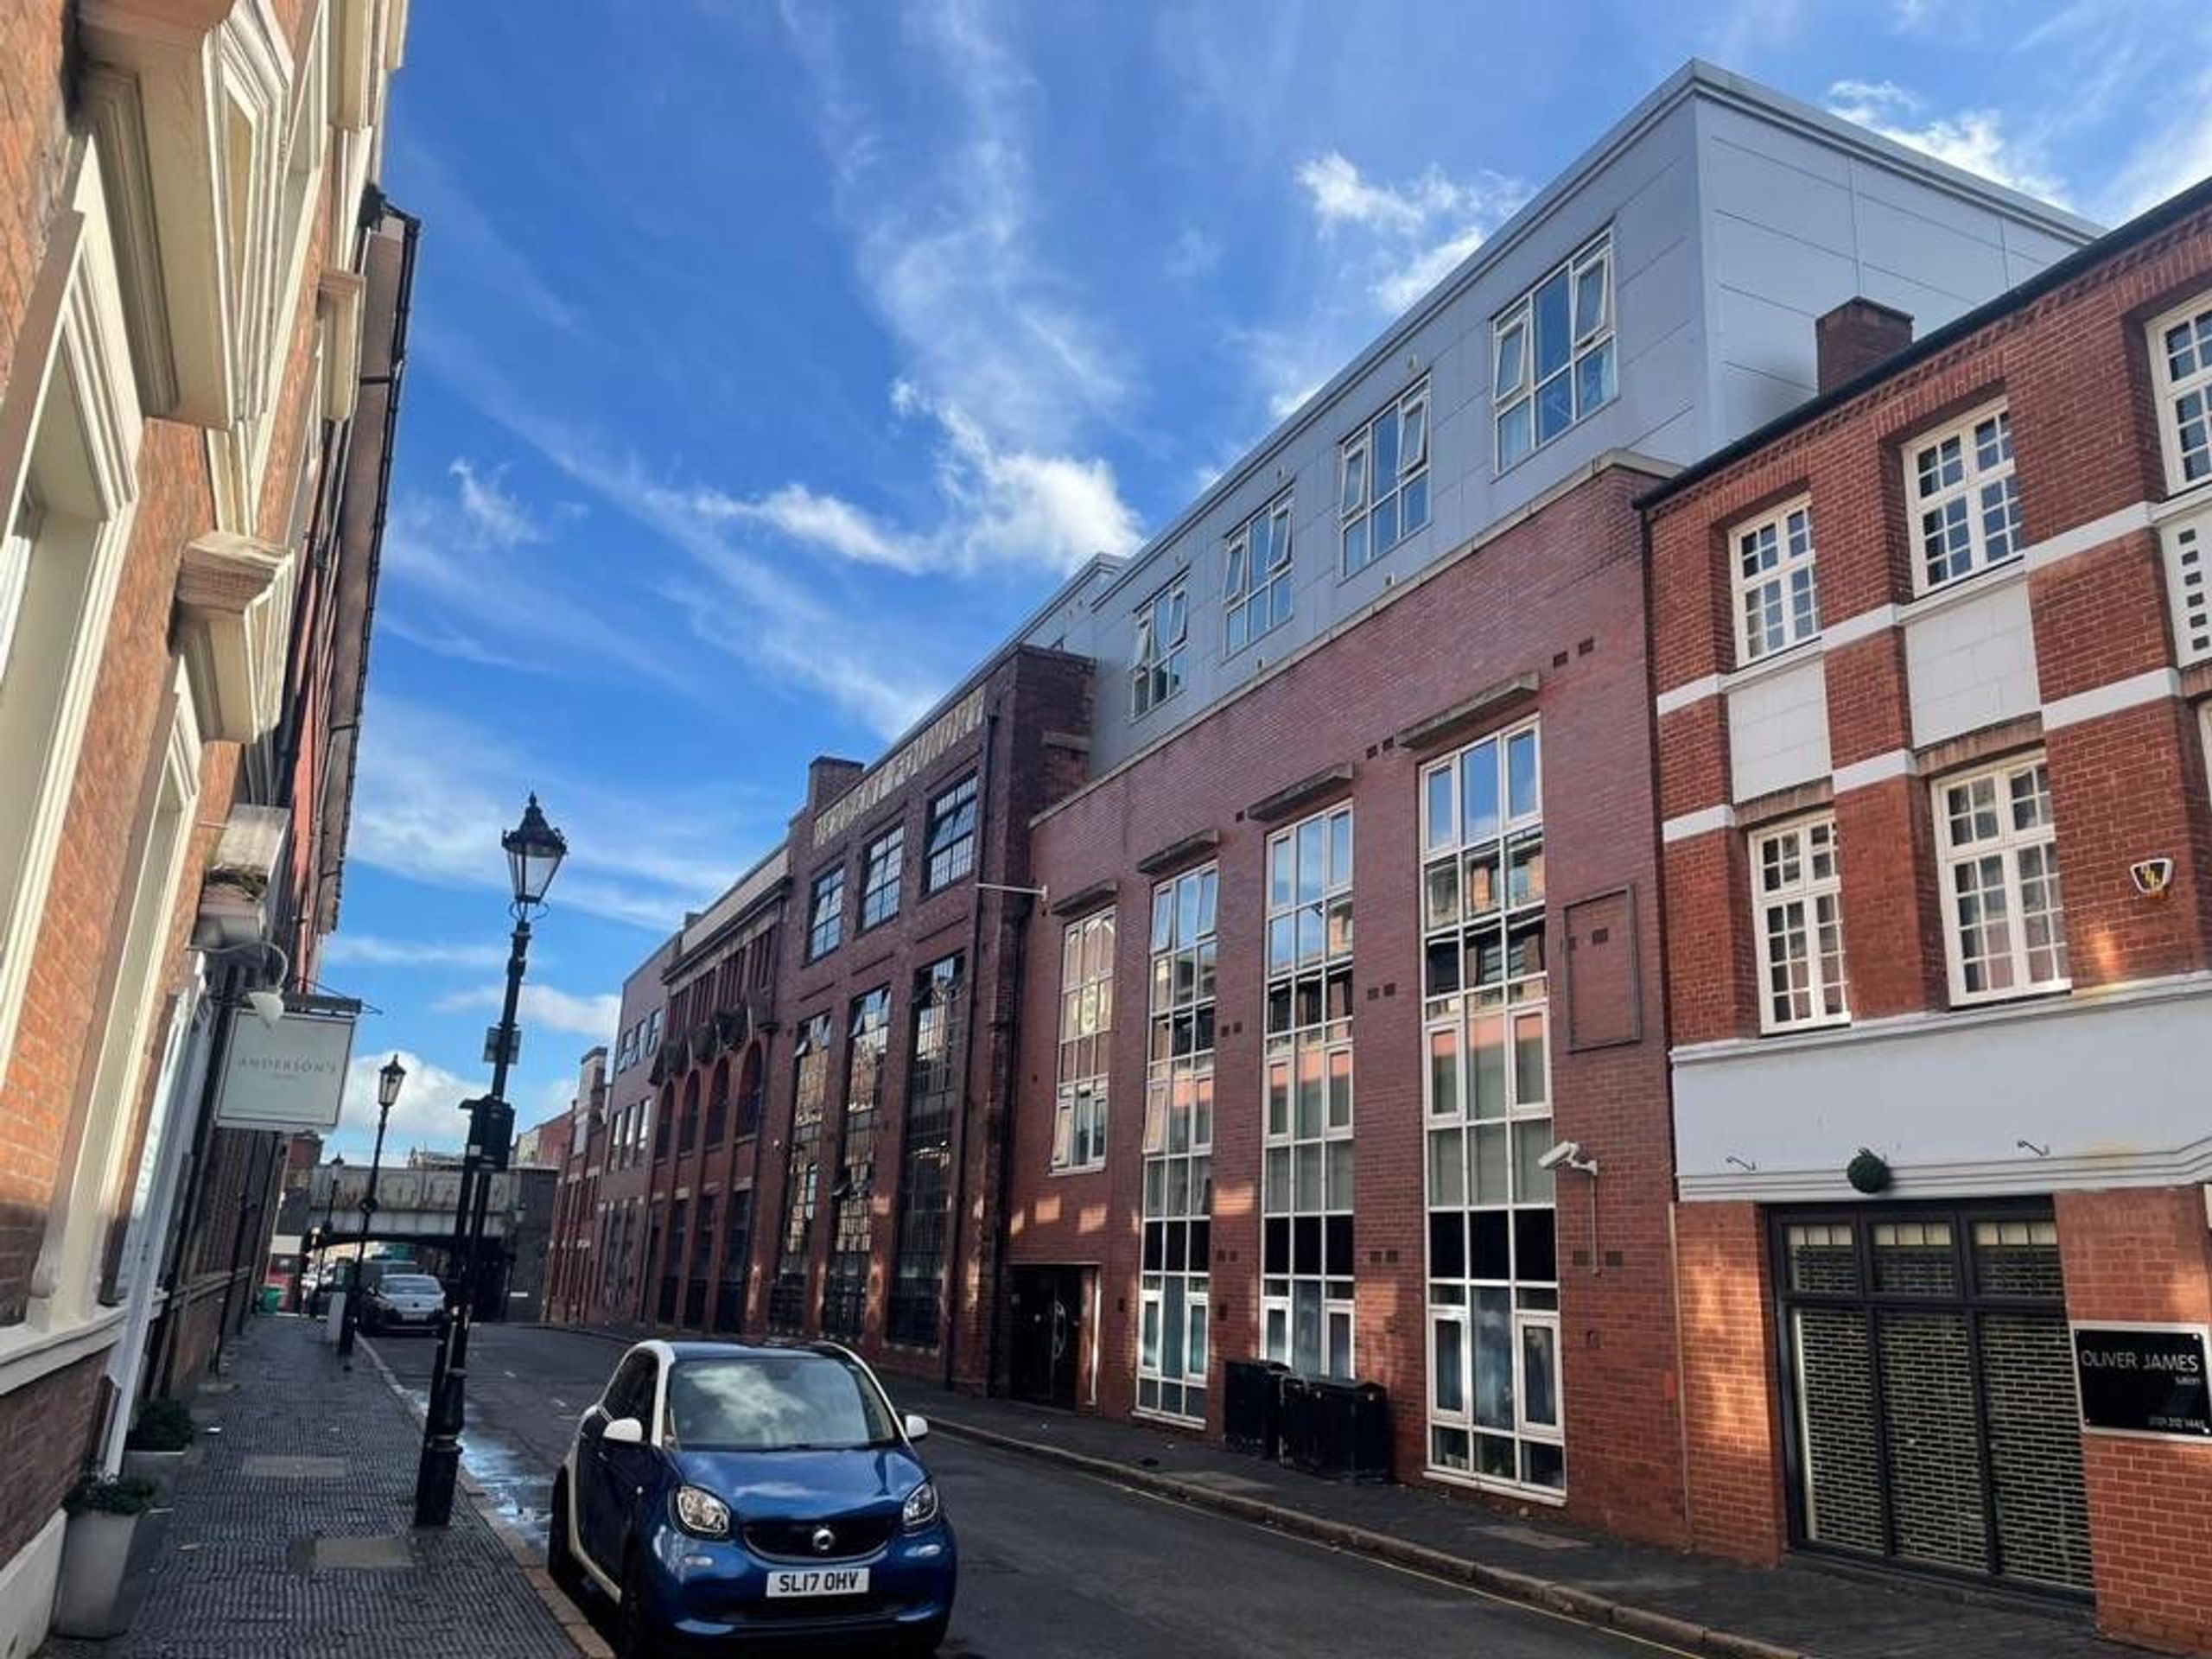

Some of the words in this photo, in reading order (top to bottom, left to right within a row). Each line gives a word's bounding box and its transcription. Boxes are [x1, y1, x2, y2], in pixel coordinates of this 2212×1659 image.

[2081, 1350, 2138, 1370] OLIVER
[2143, 1353, 2199, 1372] JAMES
[779, 1573, 820, 1592] SL17
[824, 1572, 859, 1591] OHV
